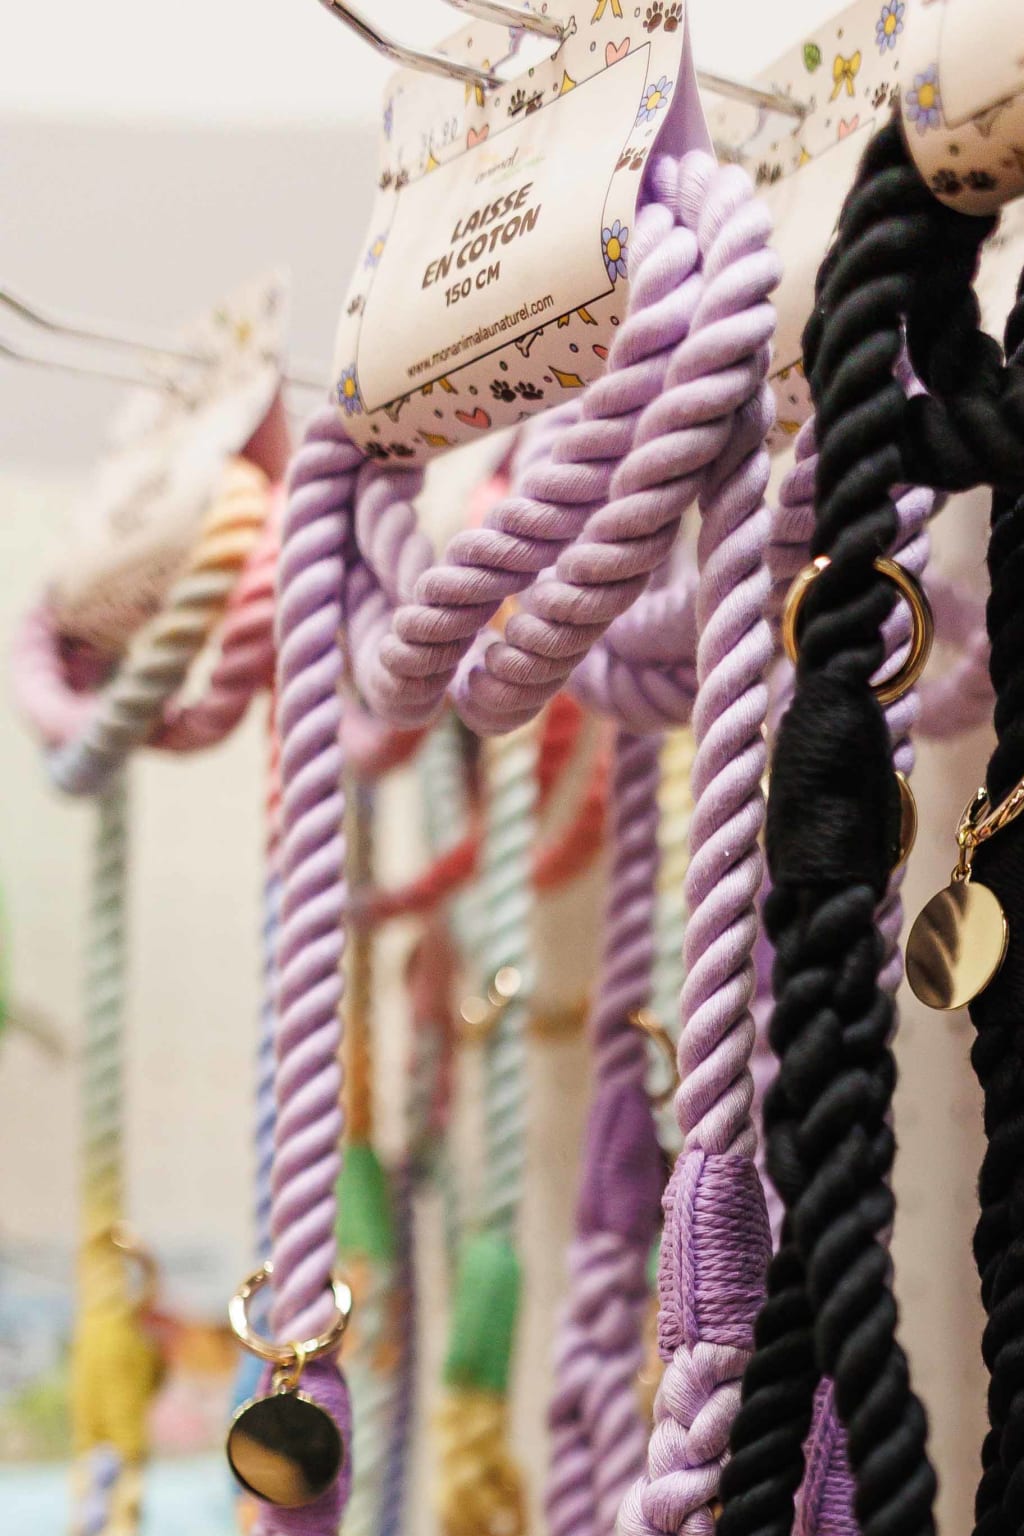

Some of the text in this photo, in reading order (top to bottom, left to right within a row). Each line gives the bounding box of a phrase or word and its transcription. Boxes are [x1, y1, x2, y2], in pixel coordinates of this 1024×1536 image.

[422, 204, 541, 290] EN COTON
[451, 182, 533, 245] LAISSE
[445, 261, 500, 307] 150 CM
[408, 294, 554, 377] www.monanimalaunaturel.com
